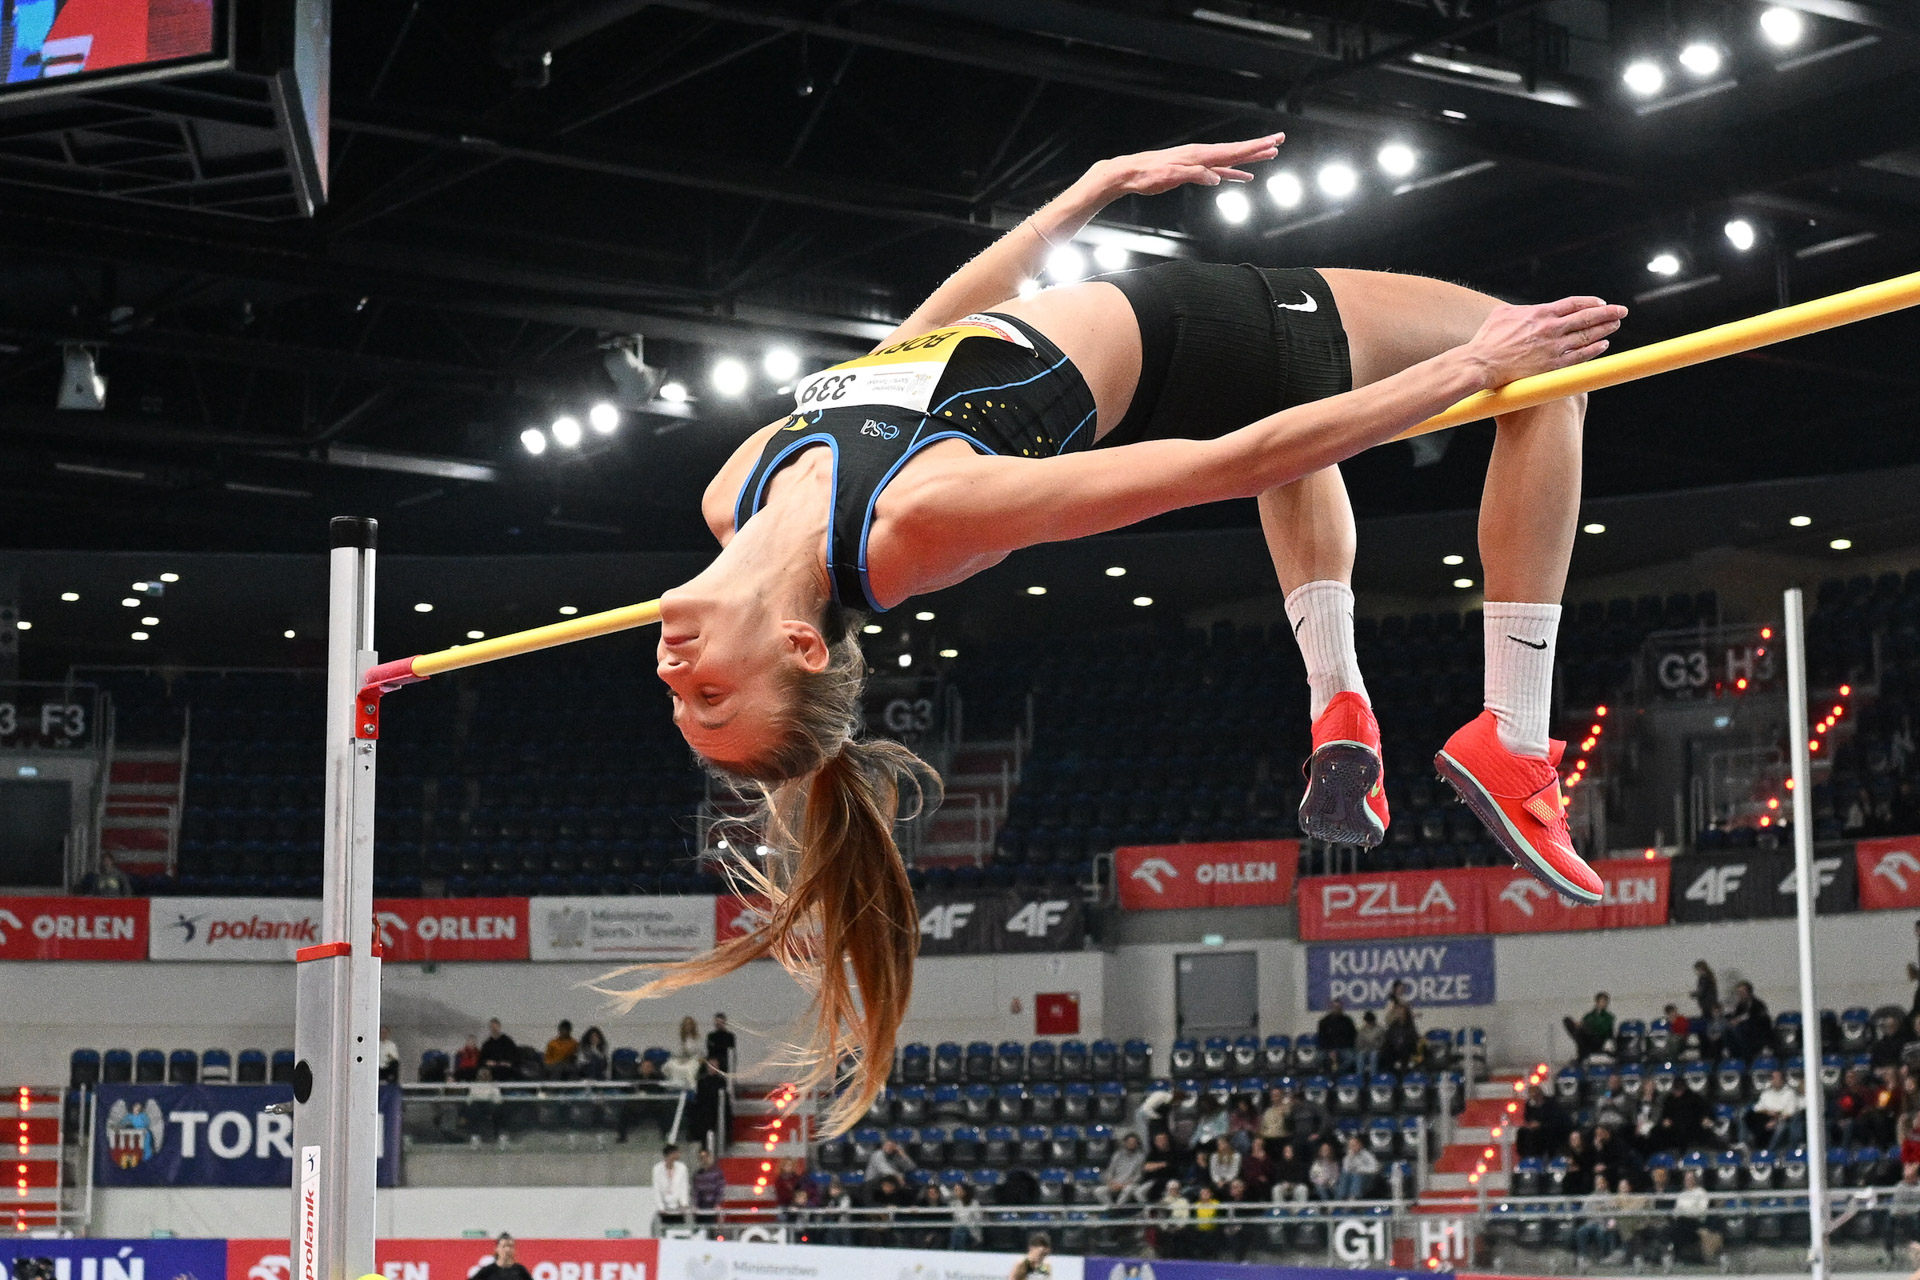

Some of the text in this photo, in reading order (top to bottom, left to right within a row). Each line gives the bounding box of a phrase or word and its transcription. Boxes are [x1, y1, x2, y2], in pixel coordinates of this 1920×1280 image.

[801, 374, 857, 404] 339
[860, 419, 900, 440] esa
[1658, 652, 1708, 688] G3
[0, 703, 85, 736] 3 F3
[884, 699, 933, 732] G3
[1195, 862, 1277, 884] ORLEN
[1684, 863, 1748, 905] 4F
[1321, 879, 1456, 918] PZLA
[32, 914, 135, 941] ORLEN
[206, 914, 319, 946] polanik
[416, 915, 517, 941] ORLEN
[918, 902, 976, 940] 4F
[1006, 900, 1069, 938] 4F
[1329, 947, 1447, 975] KUJAWY
[1330, 973, 1473, 1002] POMORZE
[169, 1110, 384, 1159] TOR
[304, 1189, 315, 1280] polanik
[1334, 1218, 1385, 1262] G1
[1420, 1219, 1465, 1260] H1
